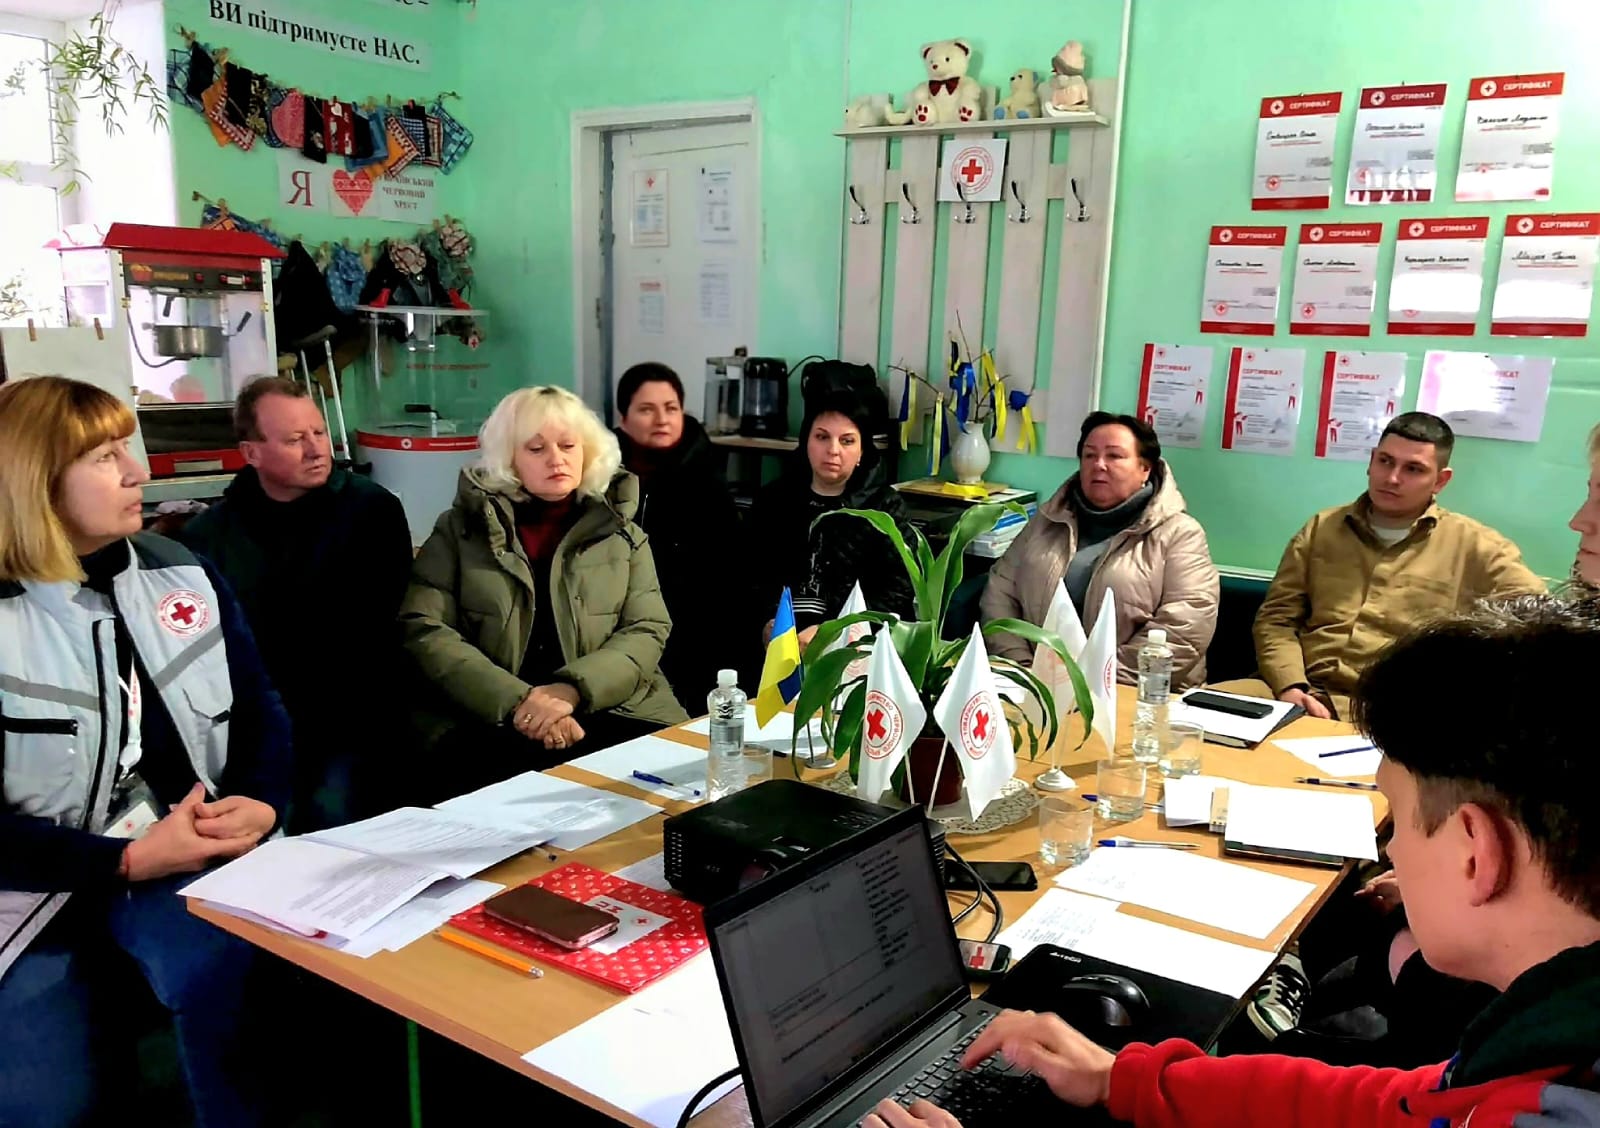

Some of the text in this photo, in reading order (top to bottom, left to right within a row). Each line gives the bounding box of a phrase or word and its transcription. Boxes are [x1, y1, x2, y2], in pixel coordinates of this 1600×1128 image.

[210, 0, 242, 25] ВИ
[373, 36, 420, 65] НАС.
[287, 170, 313, 207] Я
